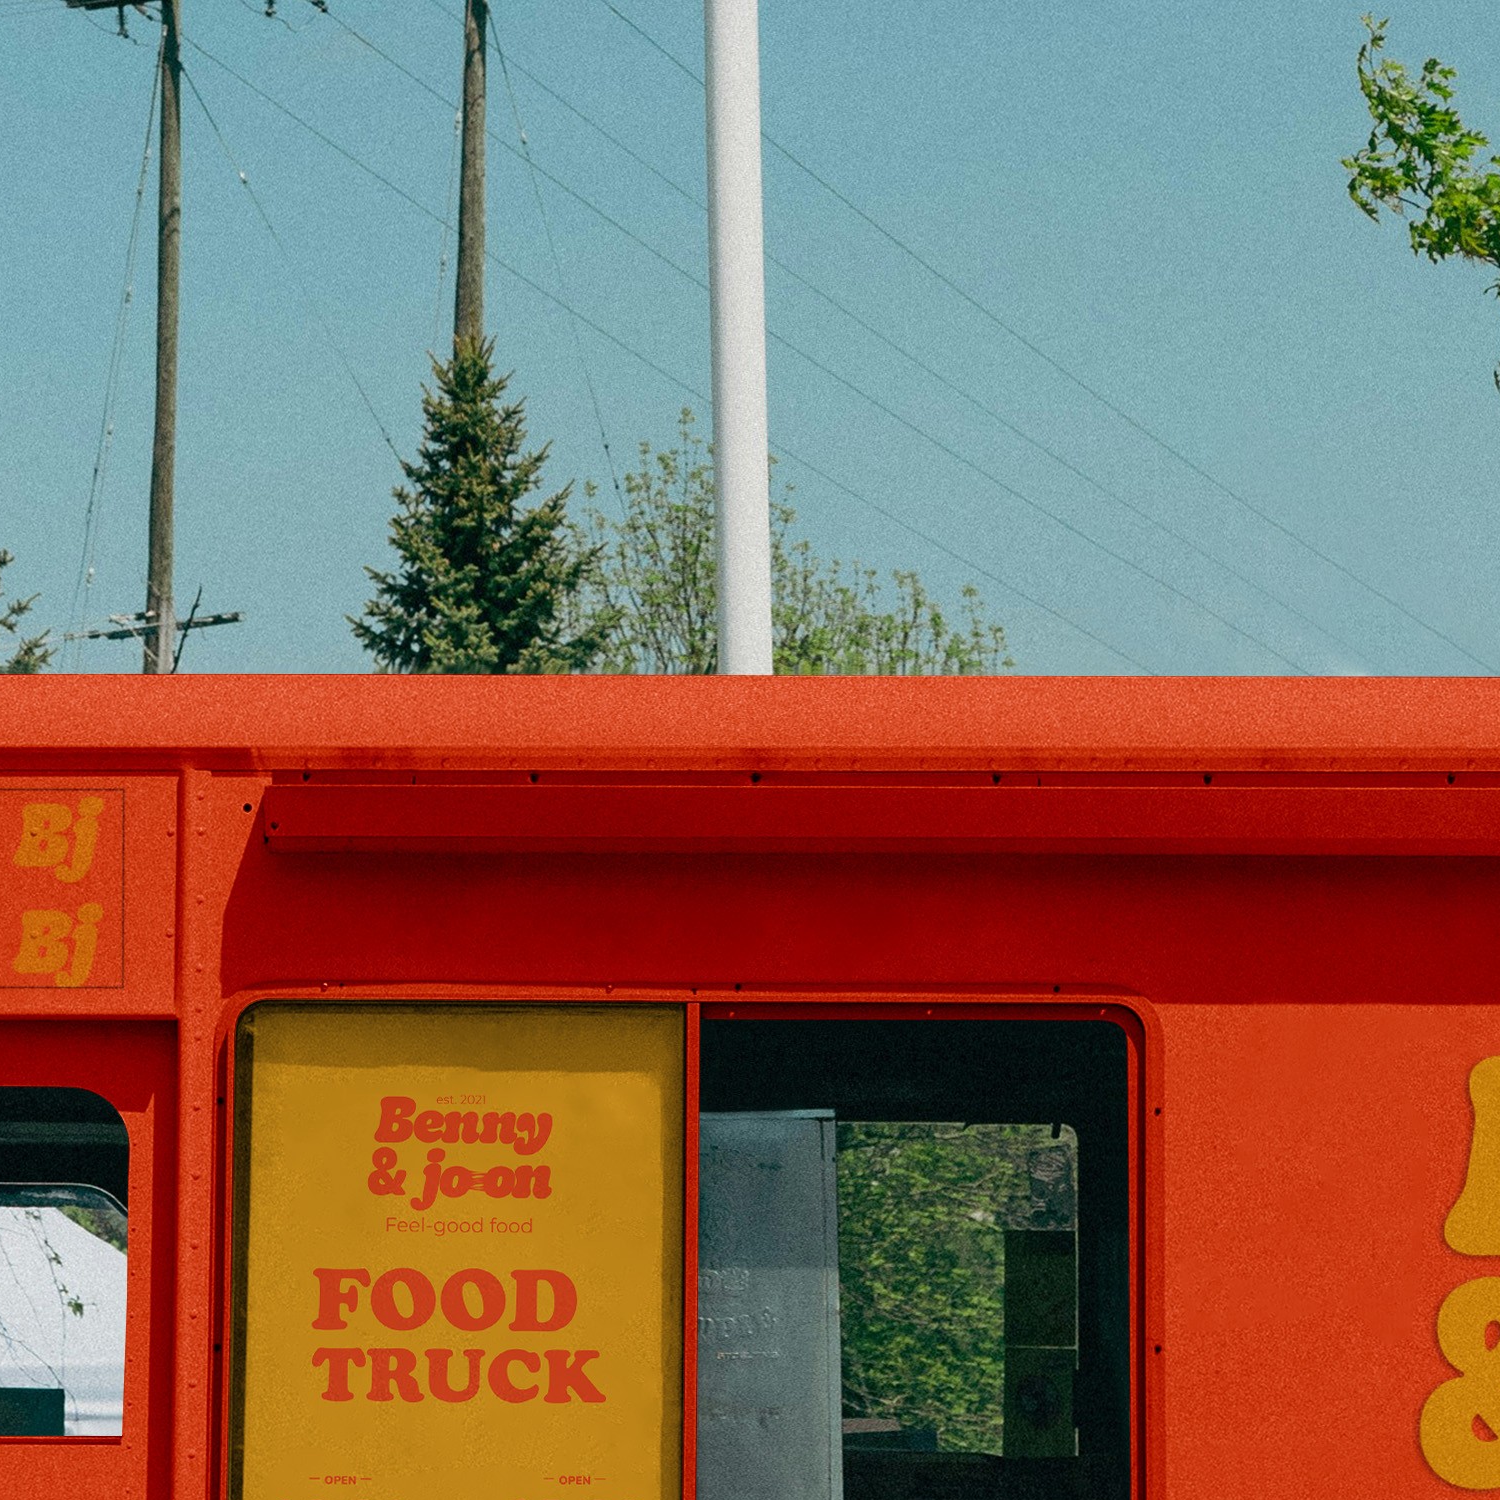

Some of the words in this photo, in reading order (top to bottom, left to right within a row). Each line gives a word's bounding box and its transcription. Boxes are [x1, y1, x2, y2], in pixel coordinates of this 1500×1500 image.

[13, 796, 104, 882] Bj
[13, 903, 103, 987] Bj
[374, 1096, 553, 1156] Benny
[436, 1095, 455, 1105] est.
[460, 1094, 487, 1105] 2021
[367, 1146, 407, 1196] &
[410, 1147, 553, 1212] joon
[385, 1216, 484, 1237] Feel-good
[489, 1216, 534, 1234] food
[311, 1267, 578, 1332] FOOD
[311, 1347, 607, 1404] TRUCK
[324, 1475, 357, 1486] OPEN
[558, 1475, 591, 1486] OPEN
